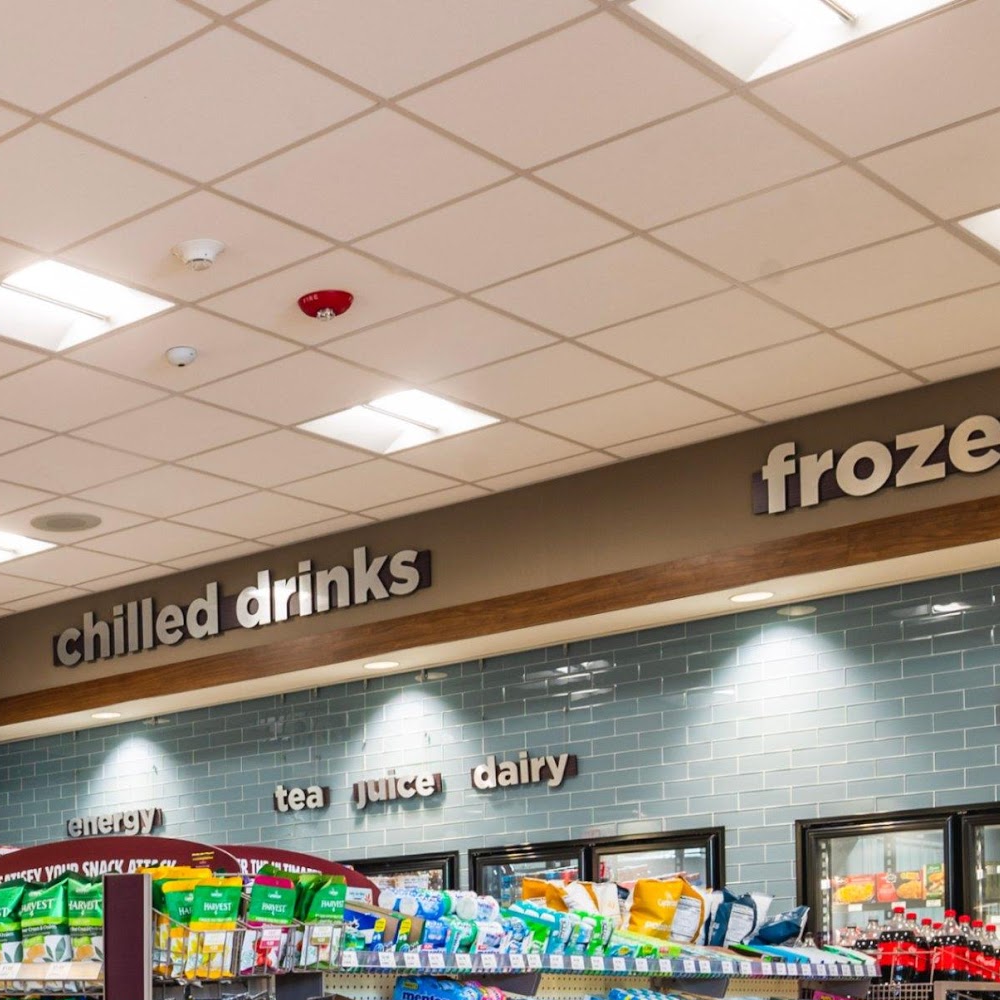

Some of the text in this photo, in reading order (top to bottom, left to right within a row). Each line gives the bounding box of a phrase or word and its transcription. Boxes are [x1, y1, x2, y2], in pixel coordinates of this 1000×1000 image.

[762, 415, 1000, 514] froze
[57, 546, 421, 666] chilled drinks
[473, 752, 568, 790] dairy
[275, 785, 324, 812] tea
[356, 769, 435, 809] juice
[67, 805, 158, 838] energy
[45, 862, 79, 880] YOUR
[82, 859, 124, 877] SNACK
[204, 902, 232, 915] HARVEST
